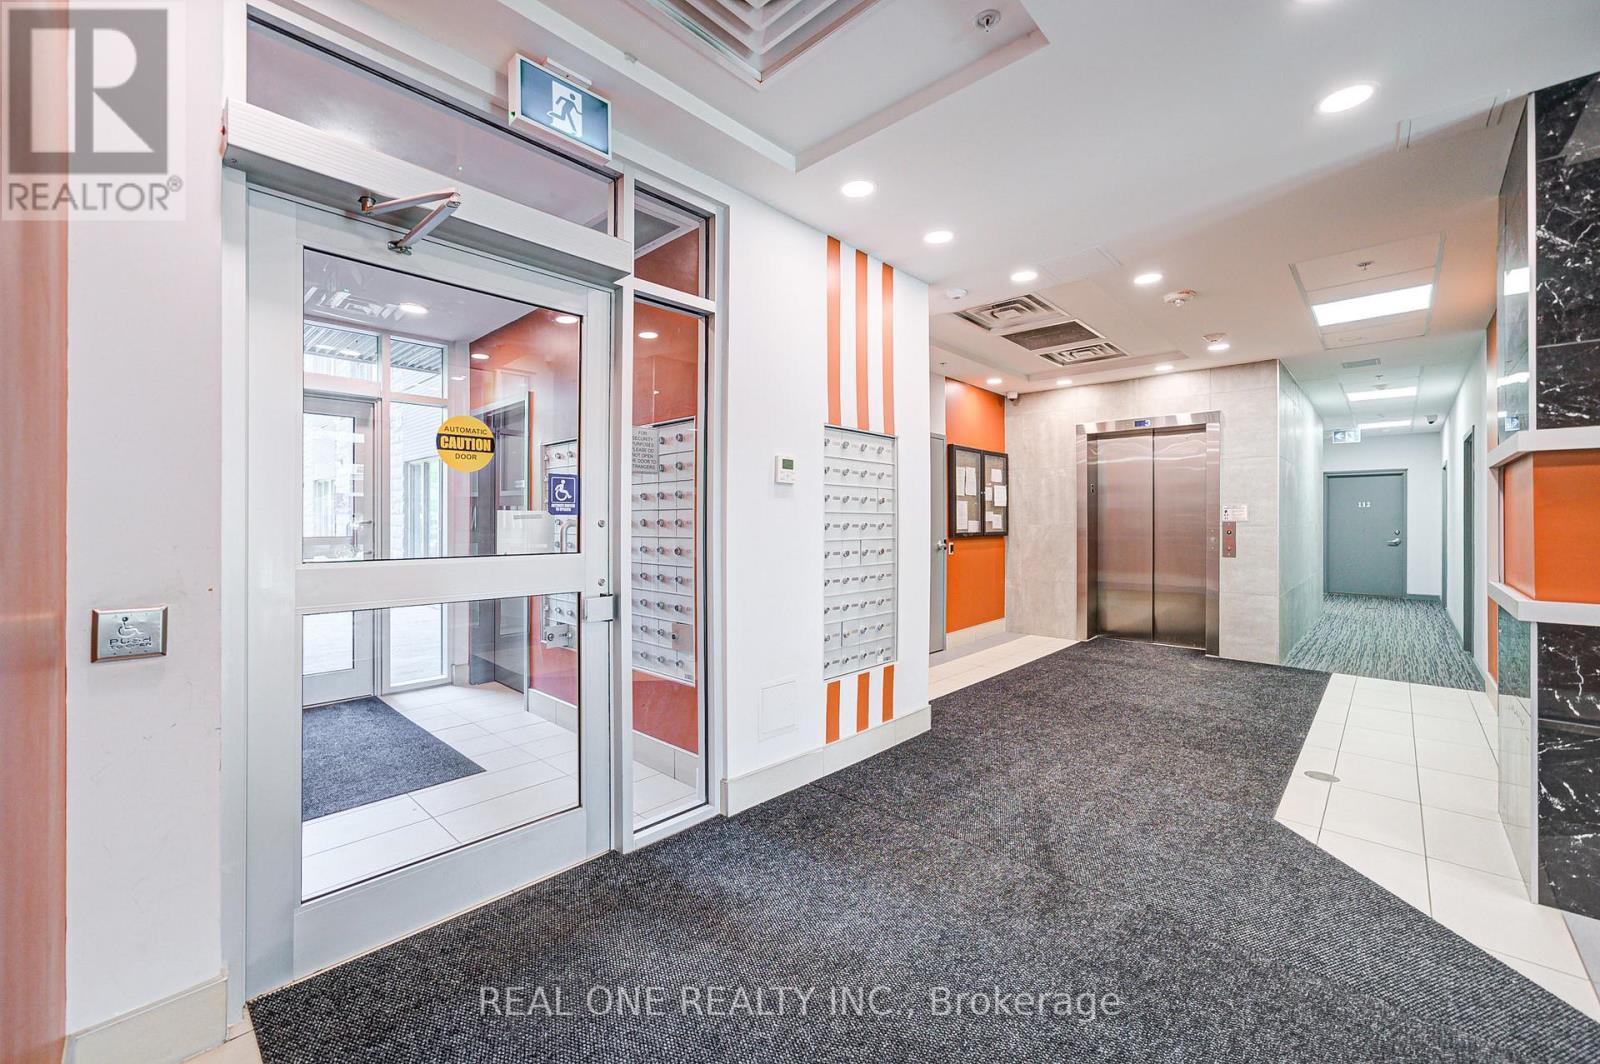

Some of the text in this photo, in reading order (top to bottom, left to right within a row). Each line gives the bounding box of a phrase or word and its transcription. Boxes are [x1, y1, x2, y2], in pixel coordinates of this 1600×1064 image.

[444, 425, 488, 436] AUTOMATIC
[440, 435, 492, 452] CAUTION
[454, 452, 478, 461] DOOR
